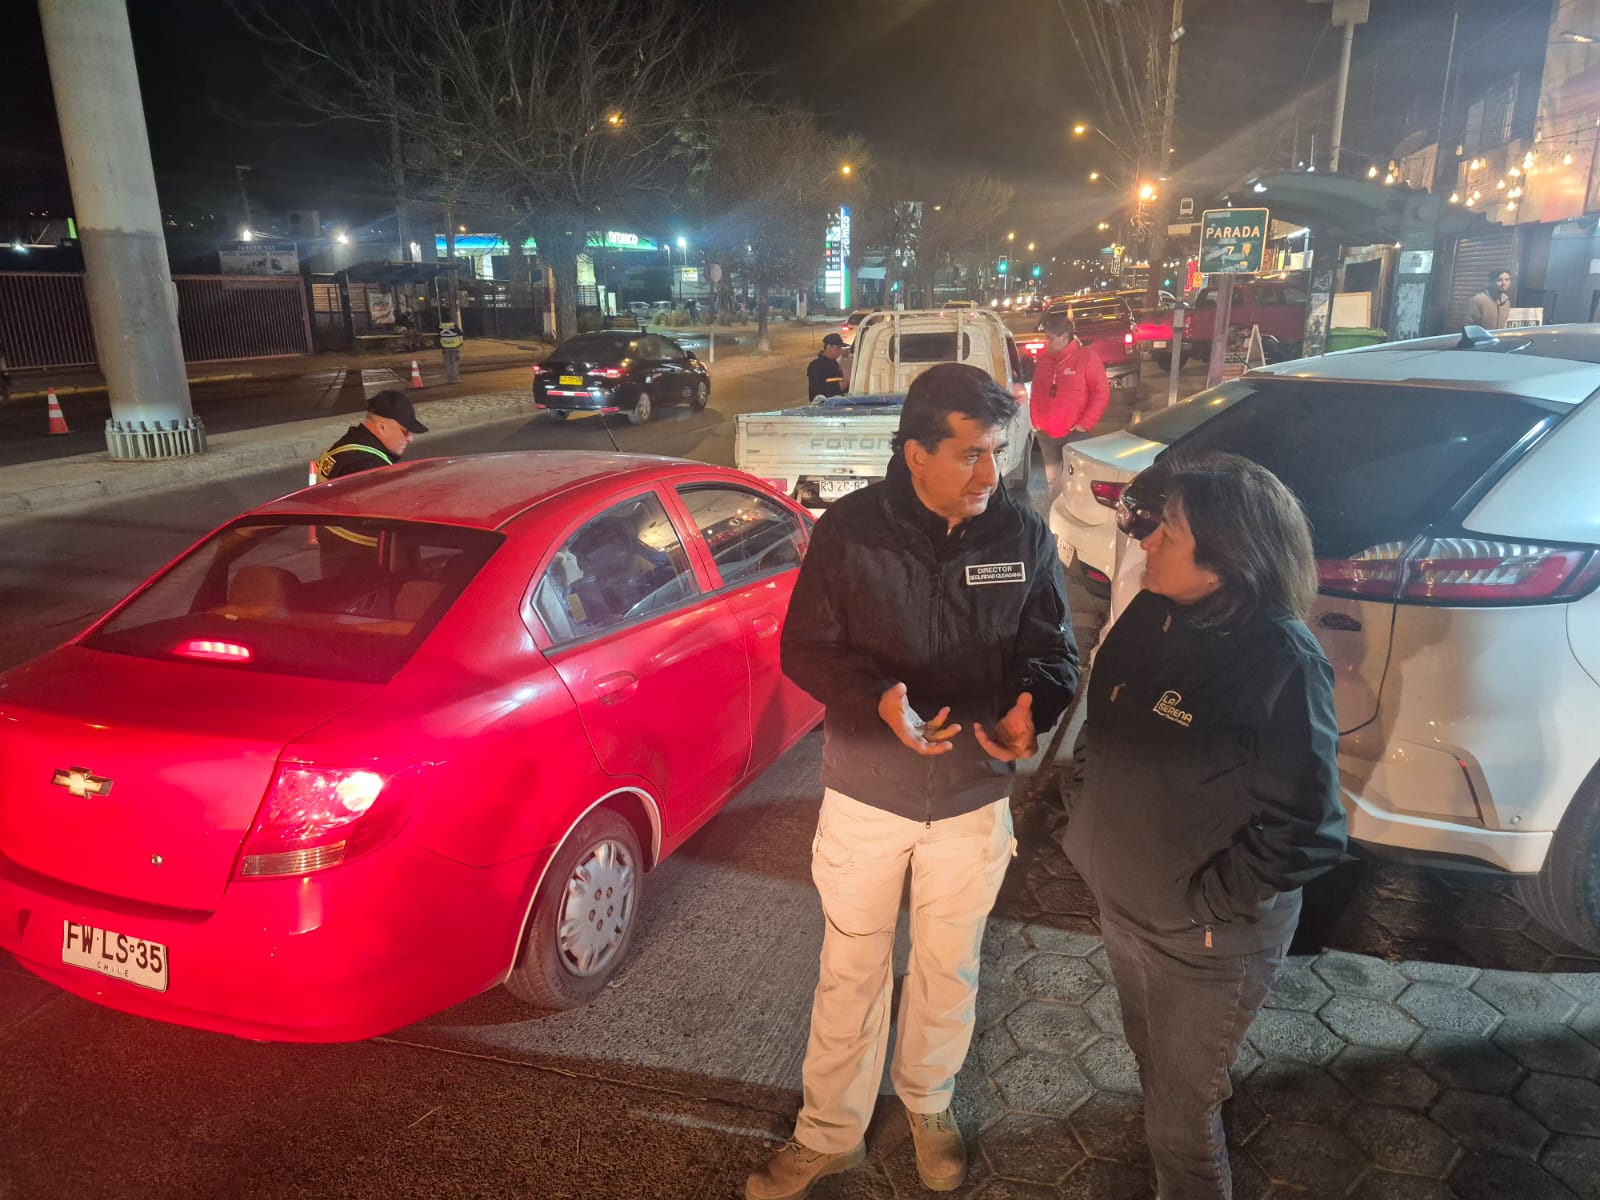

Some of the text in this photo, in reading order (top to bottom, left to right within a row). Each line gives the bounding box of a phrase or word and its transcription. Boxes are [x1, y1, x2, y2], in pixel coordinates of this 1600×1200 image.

[1206, 225, 1260, 239] PARADA
[977, 566, 1013, 574] DIRECTOR
[1162, 694, 1176, 706] LA
[1158, 702, 1193, 723] SERENA
[96, 961, 129, 978] CHILE
